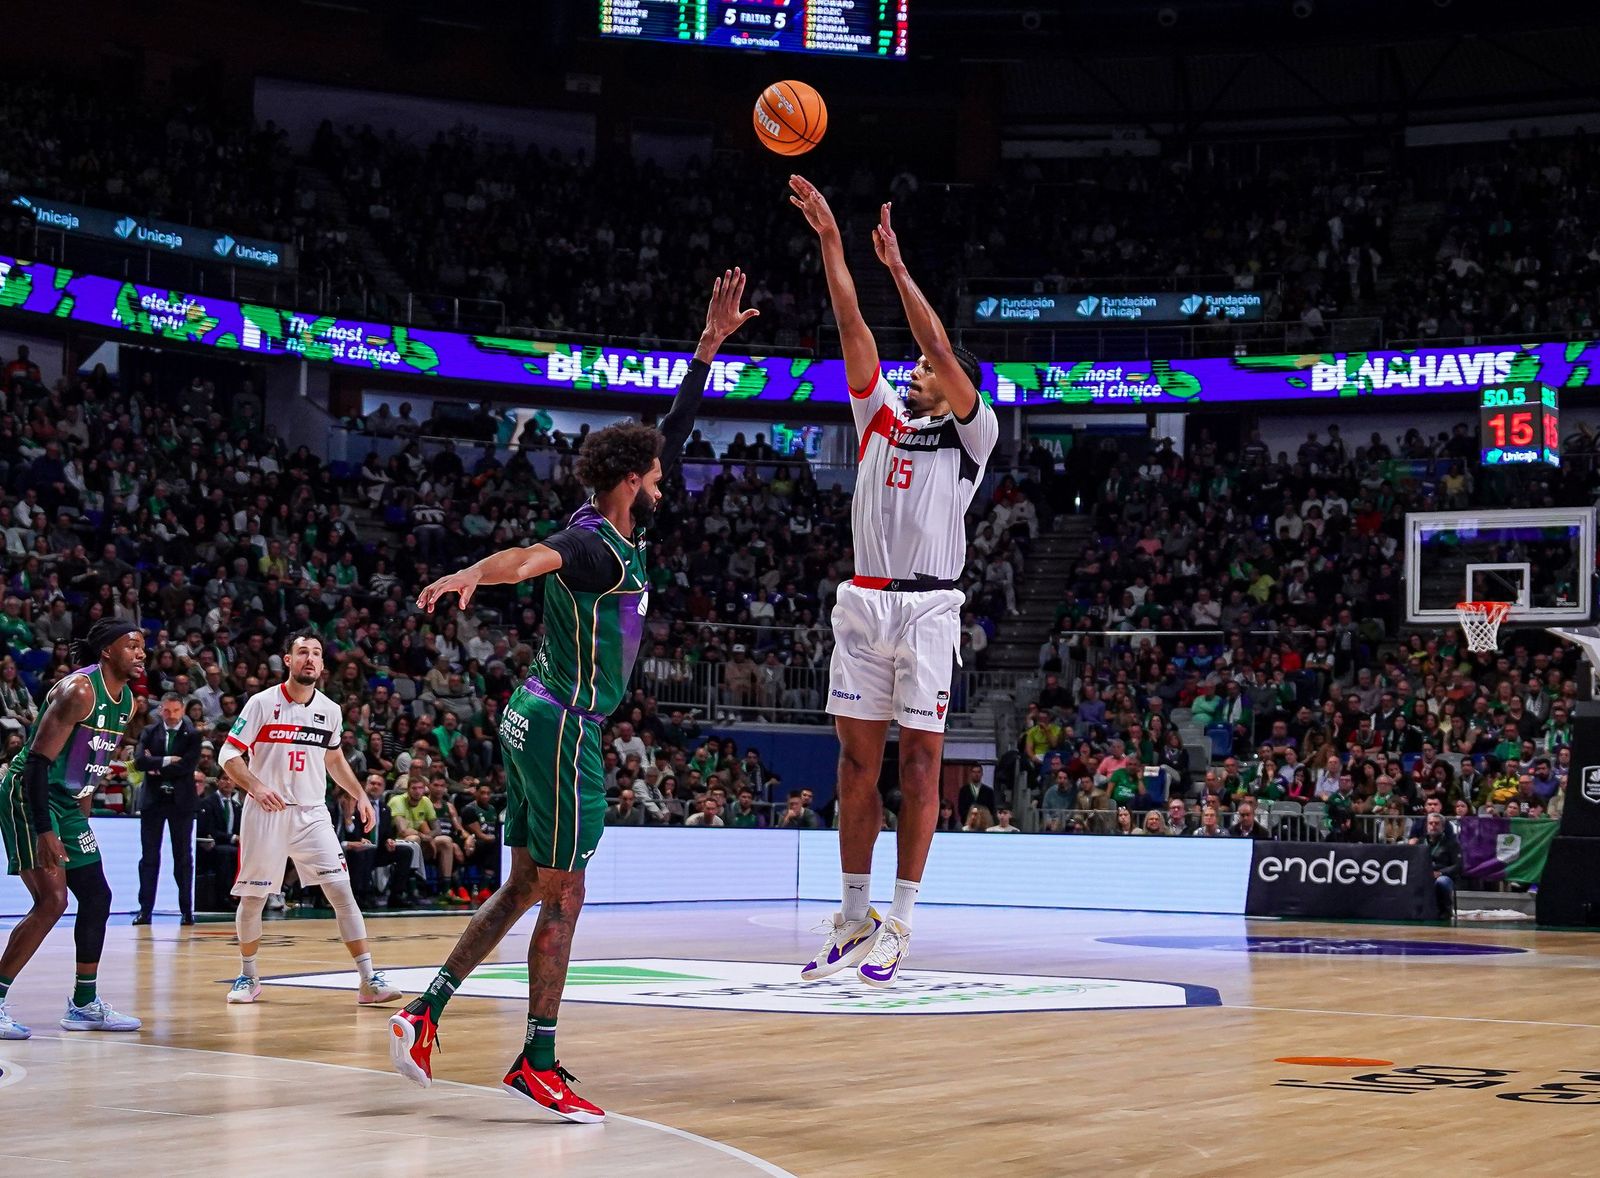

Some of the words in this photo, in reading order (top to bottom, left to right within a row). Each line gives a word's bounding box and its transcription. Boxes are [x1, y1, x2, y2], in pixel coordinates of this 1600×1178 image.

[612, 7, 649, 19] DUARTE
[613, 15, 640, 26] TILLIE
[723, 8, 737, 25] 5
[740, 12, 771, 25] FALTAS
[773, 12, 787, 29] 5
[612, 24, 643, 35] PERRY
[137, 226, 183, 249] Unicaja
[236, 245, 279, 267] Unicaja
[1001, 297, 1055, 308] Fundación
[1102, 296, 1157, 307] Fundación
[1205, 294, 1260, 306] Fundación
[1001, 306, 1041, 320] Unicaja
[1102, 306, 1142, 320] Unicaja
[347, 343, 401, 364] choice
[1108, 381, 1163, 398] choice
[1483, 387, 1527, 407] 50.5
[1487, 412, 1534, 447] 15
[1503, 451, 1538, 463] Unicaja
[886, 456, 913, 490] 25
[831, 689, 856, 701] asisa
[269, 726, 325, 744] COVIRAN
[288, 750, 306, 772] 15
[1258, 850, 1409, 885] endesa
